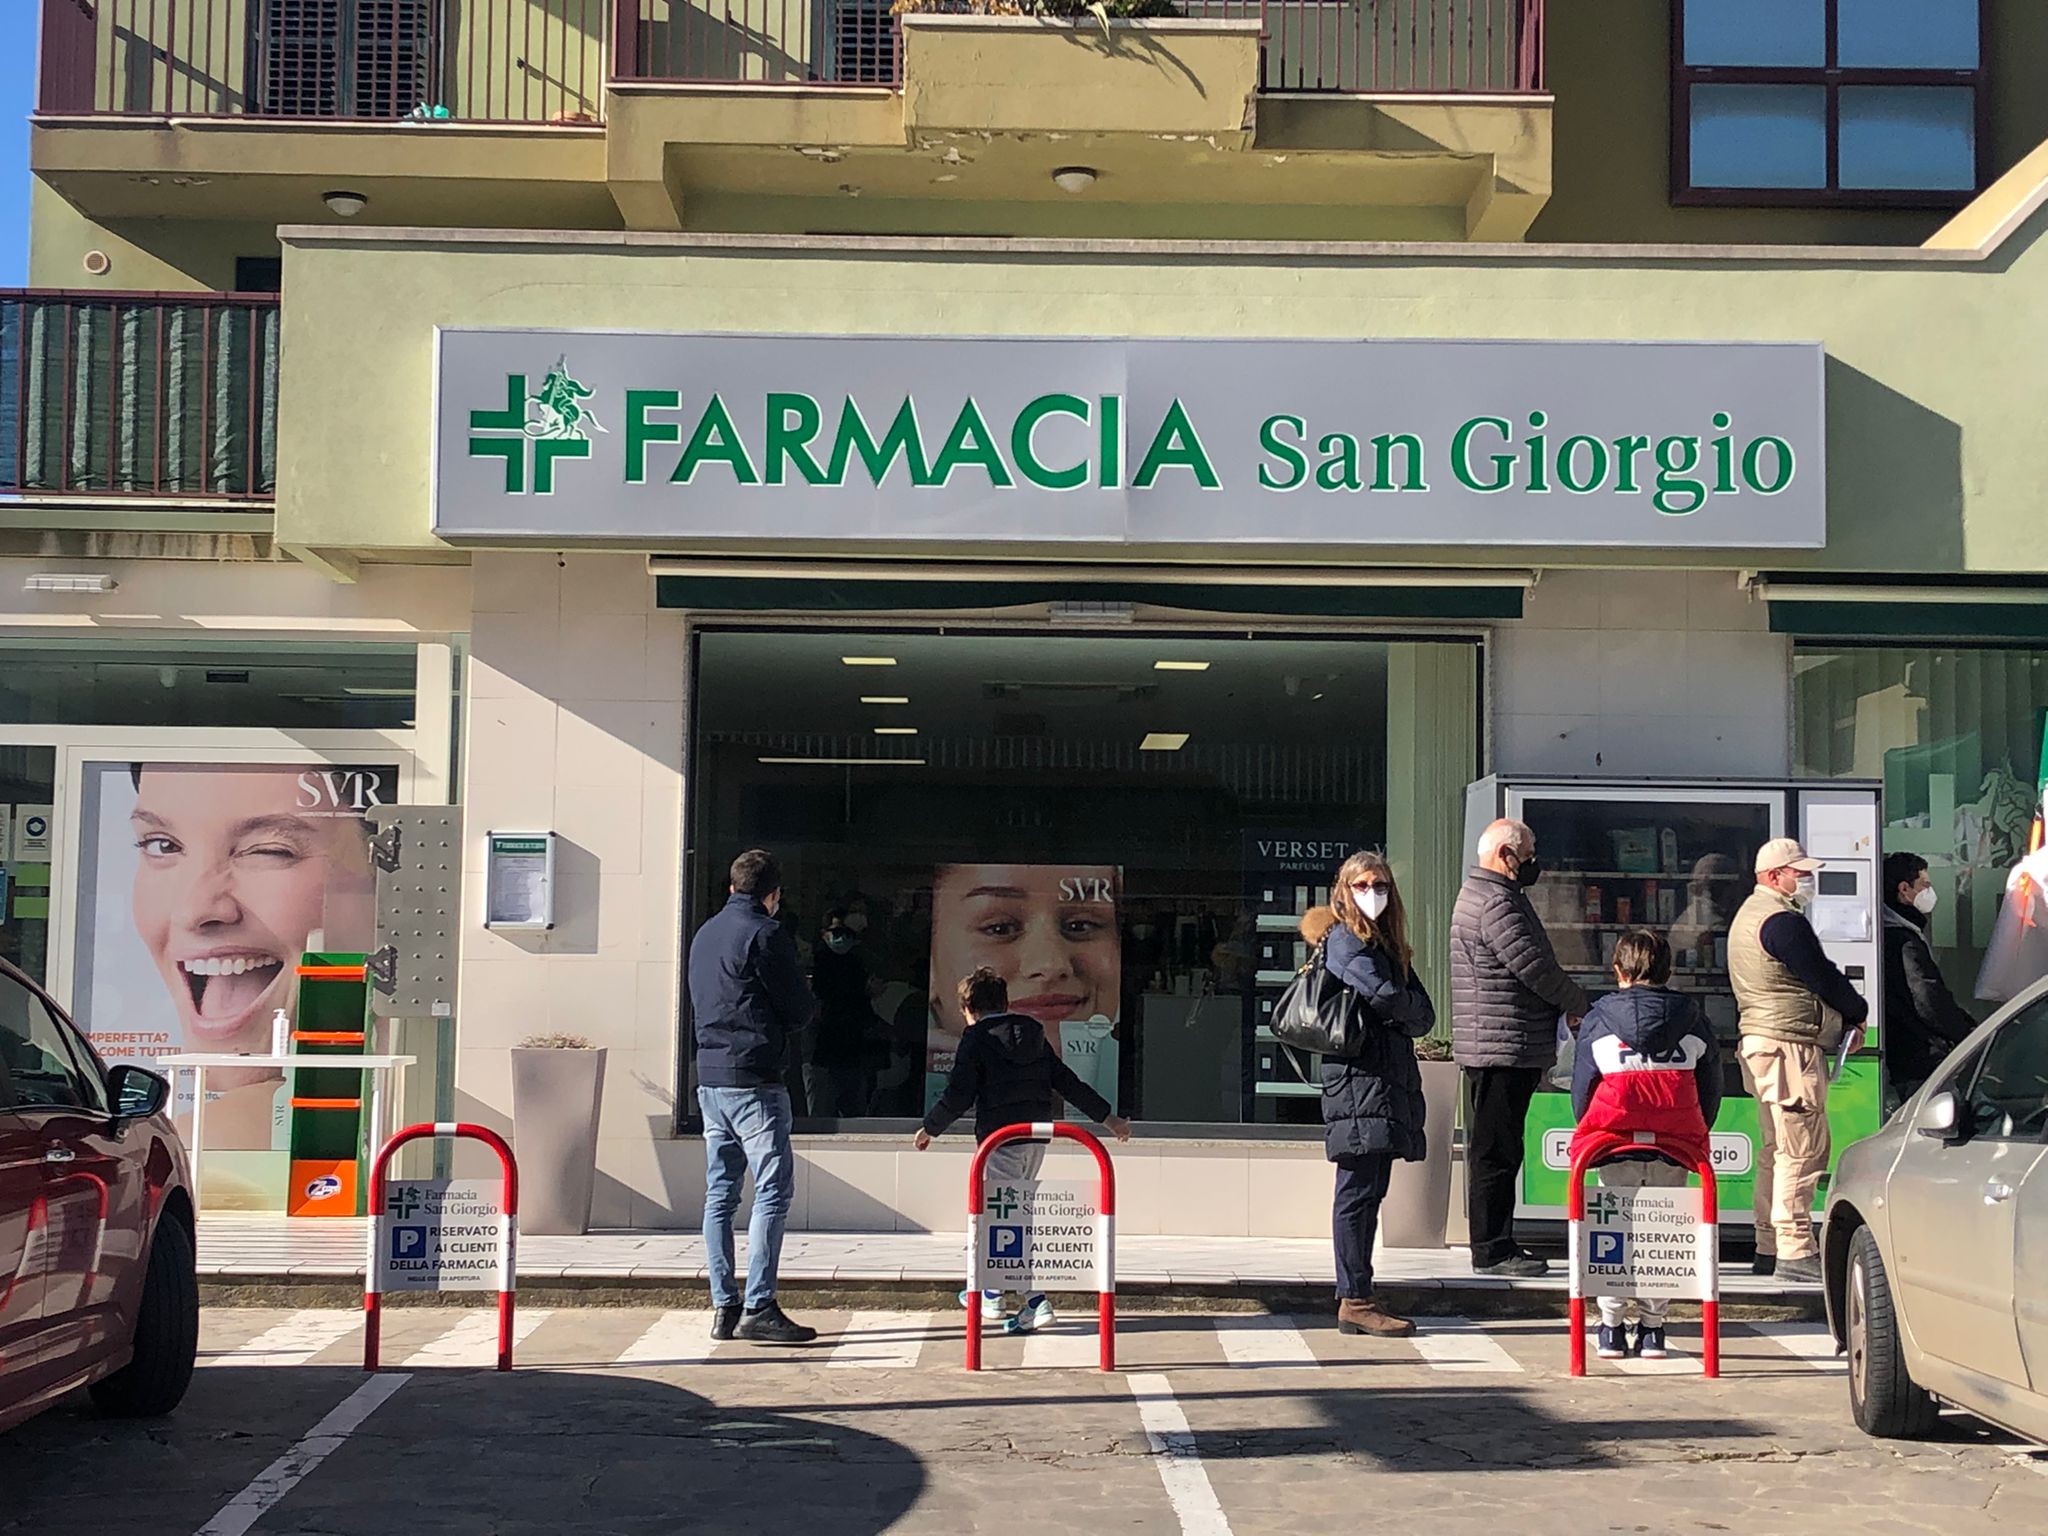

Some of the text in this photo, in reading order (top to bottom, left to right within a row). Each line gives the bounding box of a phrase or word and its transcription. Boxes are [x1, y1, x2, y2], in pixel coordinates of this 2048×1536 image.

[623, 387, 1797, 515] FARMACIA San Giorgio
[296, 770, 382, 809] SVR
[1257, 840, 1350, 859] VERSET
[1280, 862, 1326, 871] PARFUMS
[1058, 877, 1113, 903] SVR
[85, 1032, 170, 1043] MPERFETTA?
[99, 1046, 136, 1057] COME
[1067, 1039, 1097, 1054] SVR
[425, 1189, 477, 1200] Farmacia
[1023, 1190, 1075, 1201] Farmacia
[1621, 1196, 1675, 1209] Farmacia
[423, 1202, 498, 1218] San Giorgio
[1022, 1204, 1096, 1219] San Giorgio
[1622, 1210, 1696, 1227] San Giorgio
[430, 1226, 498, 1237] RISERVATO
[1025, 1225, 1093, 1236] RISERVATO
[1626, 1232, 1696, 1244] RISERVATO
[434, 1242, 498, 1253] AI CLIENTI
[1030, 1242, 1093, 1253] AI CLIENTI
[1631, 1249, 1696, 1261] AI CLIENTI
[389, 1259, 498, 1271] DELLA FARMACIA
[986, 1259, 1094, 1269] DELLA FARMACIA
[1588, 1265, 1697, 1277] DELLA FARMACIA
